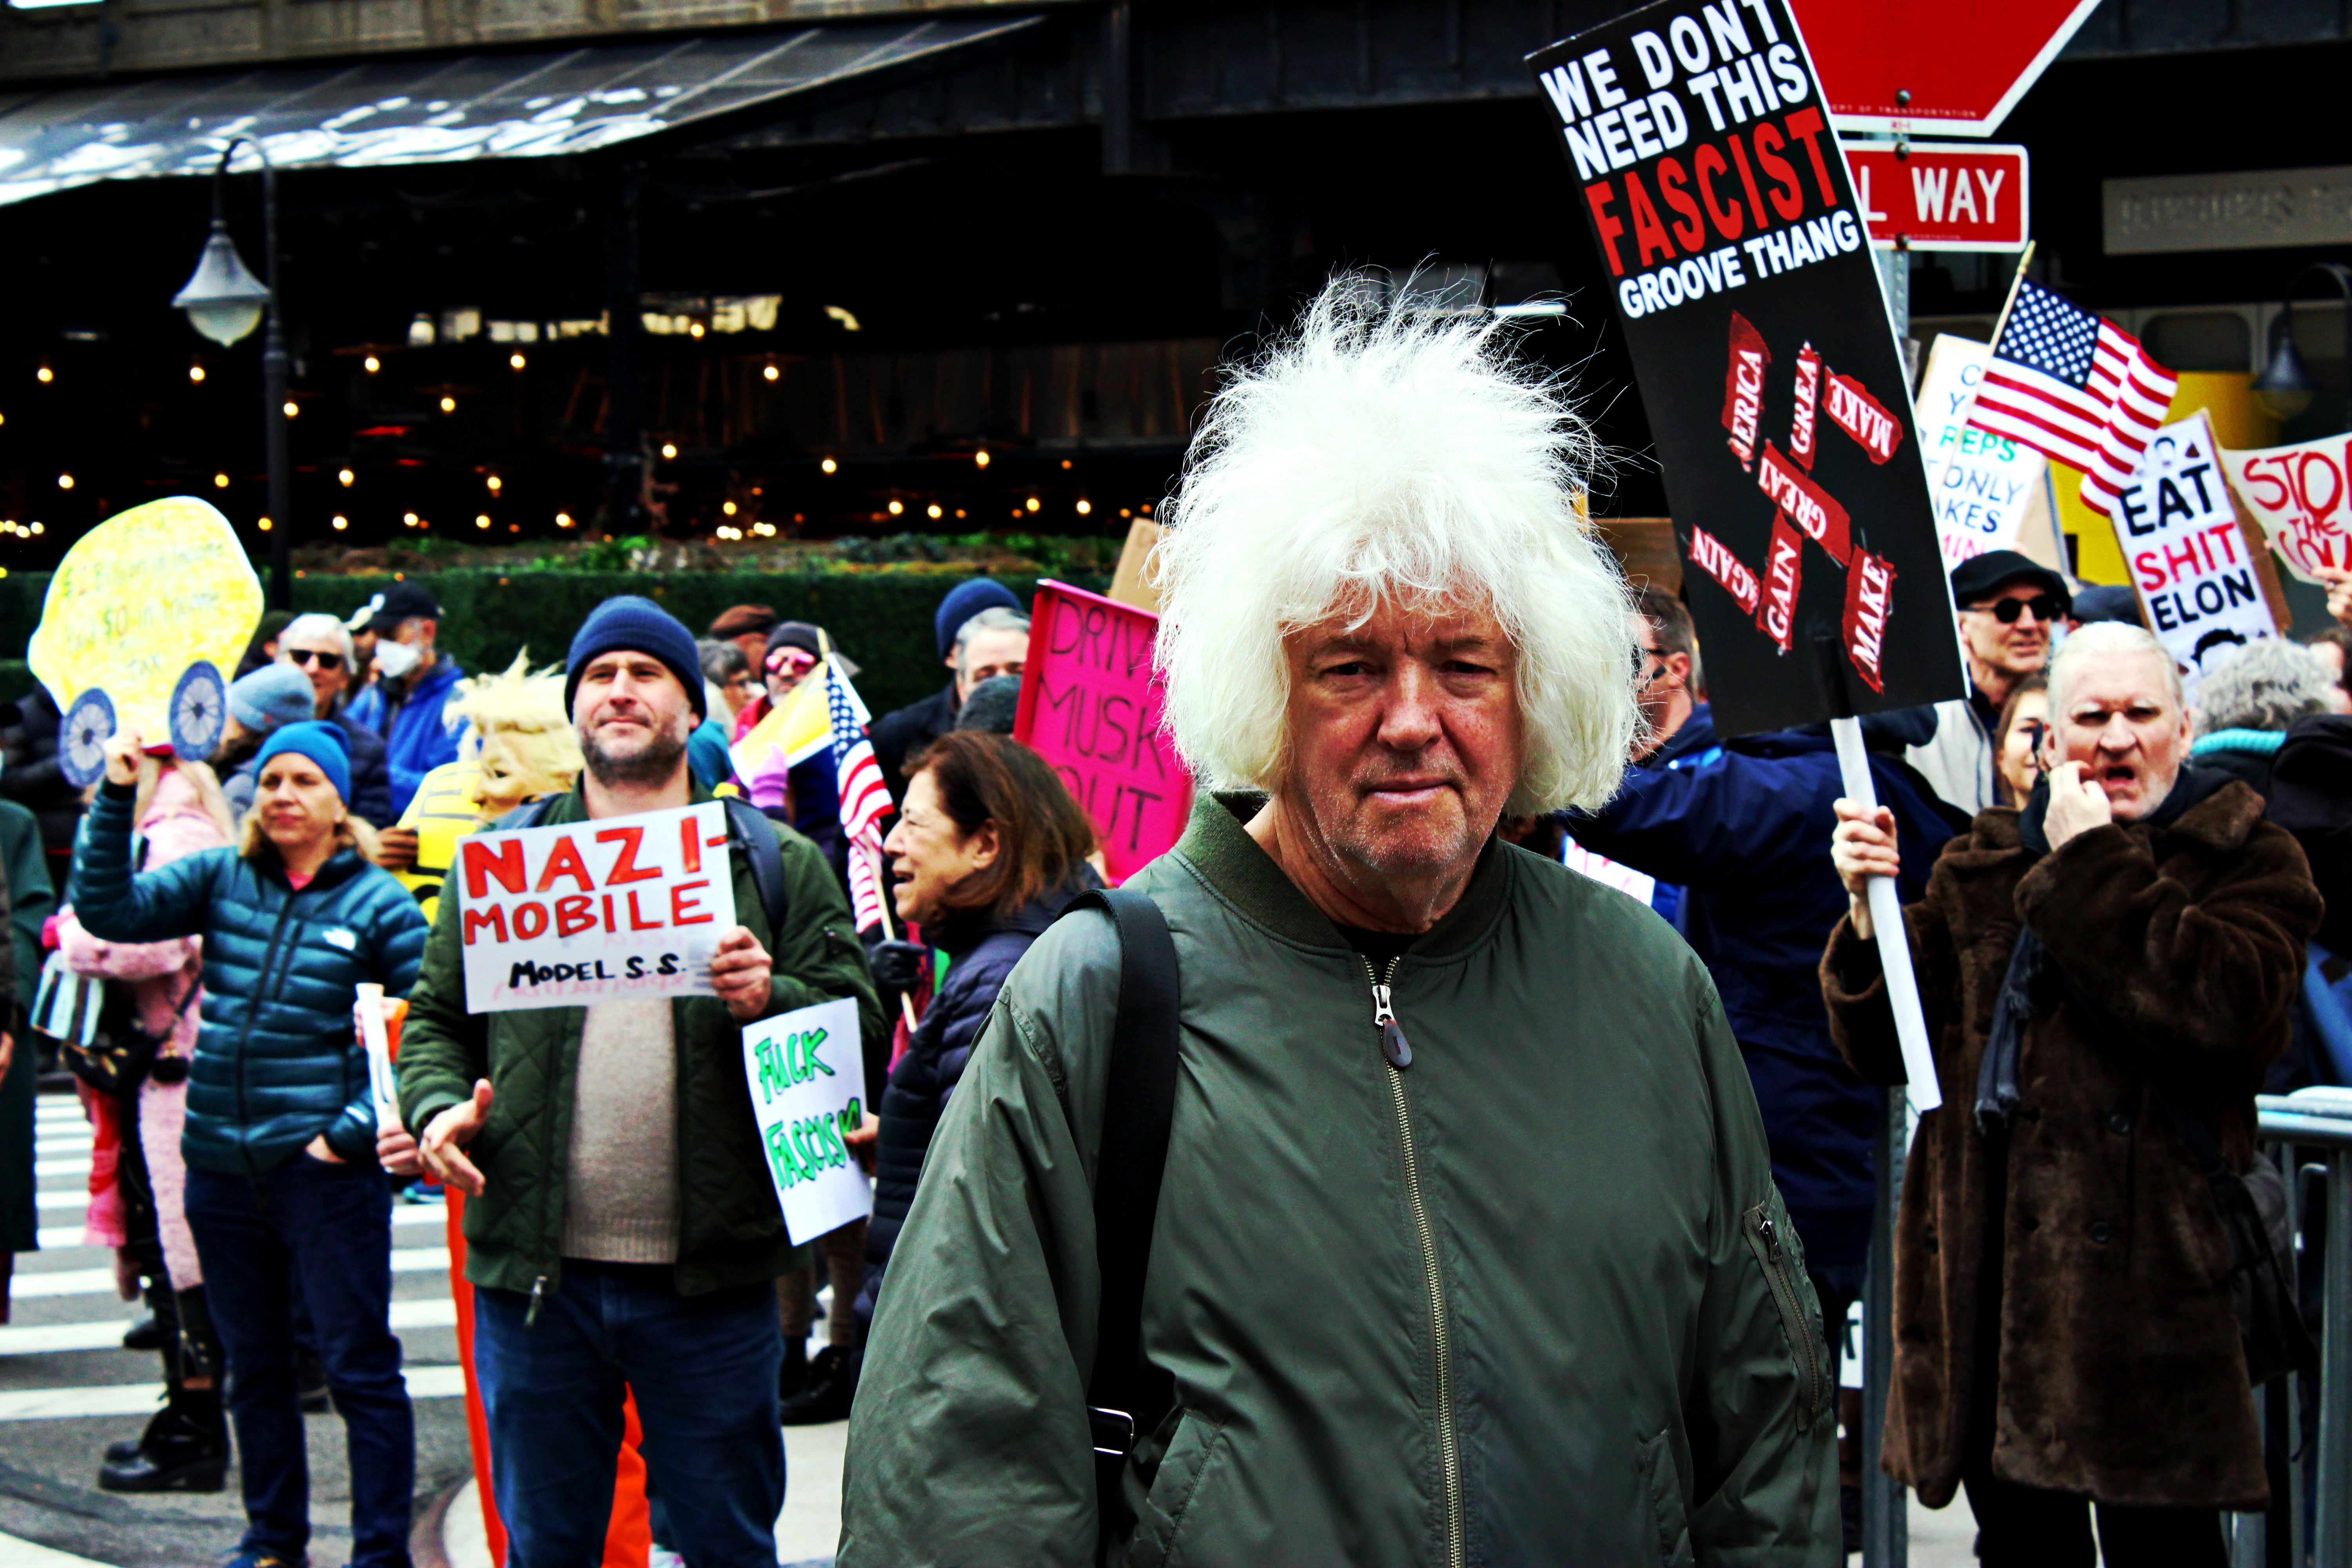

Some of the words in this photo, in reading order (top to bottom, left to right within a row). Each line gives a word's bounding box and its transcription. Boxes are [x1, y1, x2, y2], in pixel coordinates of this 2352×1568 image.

[1540, 48, 1627, 123] WE
[1563, 90, 1688, 180] NEED
[1687, 43, 1809, 131] THIS
[1584, 106, 1837, 277] FASCIST
[1911, 166, 2005, 224] WAY
[1619, 246, 1746, 319] GROOVE
[1743, 210, 1860, 279] THANG
[1789, 347, 1818, 455] GREA
[1827, 377, 1894, 457] MAKE
[1939, 425, 2018, 462] REPS
[2243, 439, 2352, 519] STO
[1944, 465, 2024, 506] ONLY
[2119, 463, 2211, 537] EAT
[2134, 522, 2236, 592] SHIT
[1852, 557, 1889, 671] MAKE
[2150, 568, 2257, 632] ELON
[1050, 596, 1170, 689] DRIV
[1031, 669, 1166, 780] MUSK
[463, 879, 715, 946] MOBILE
[508, 959, 616, 989] MODEL
[754, 1027, 835, 1105] FUCK
